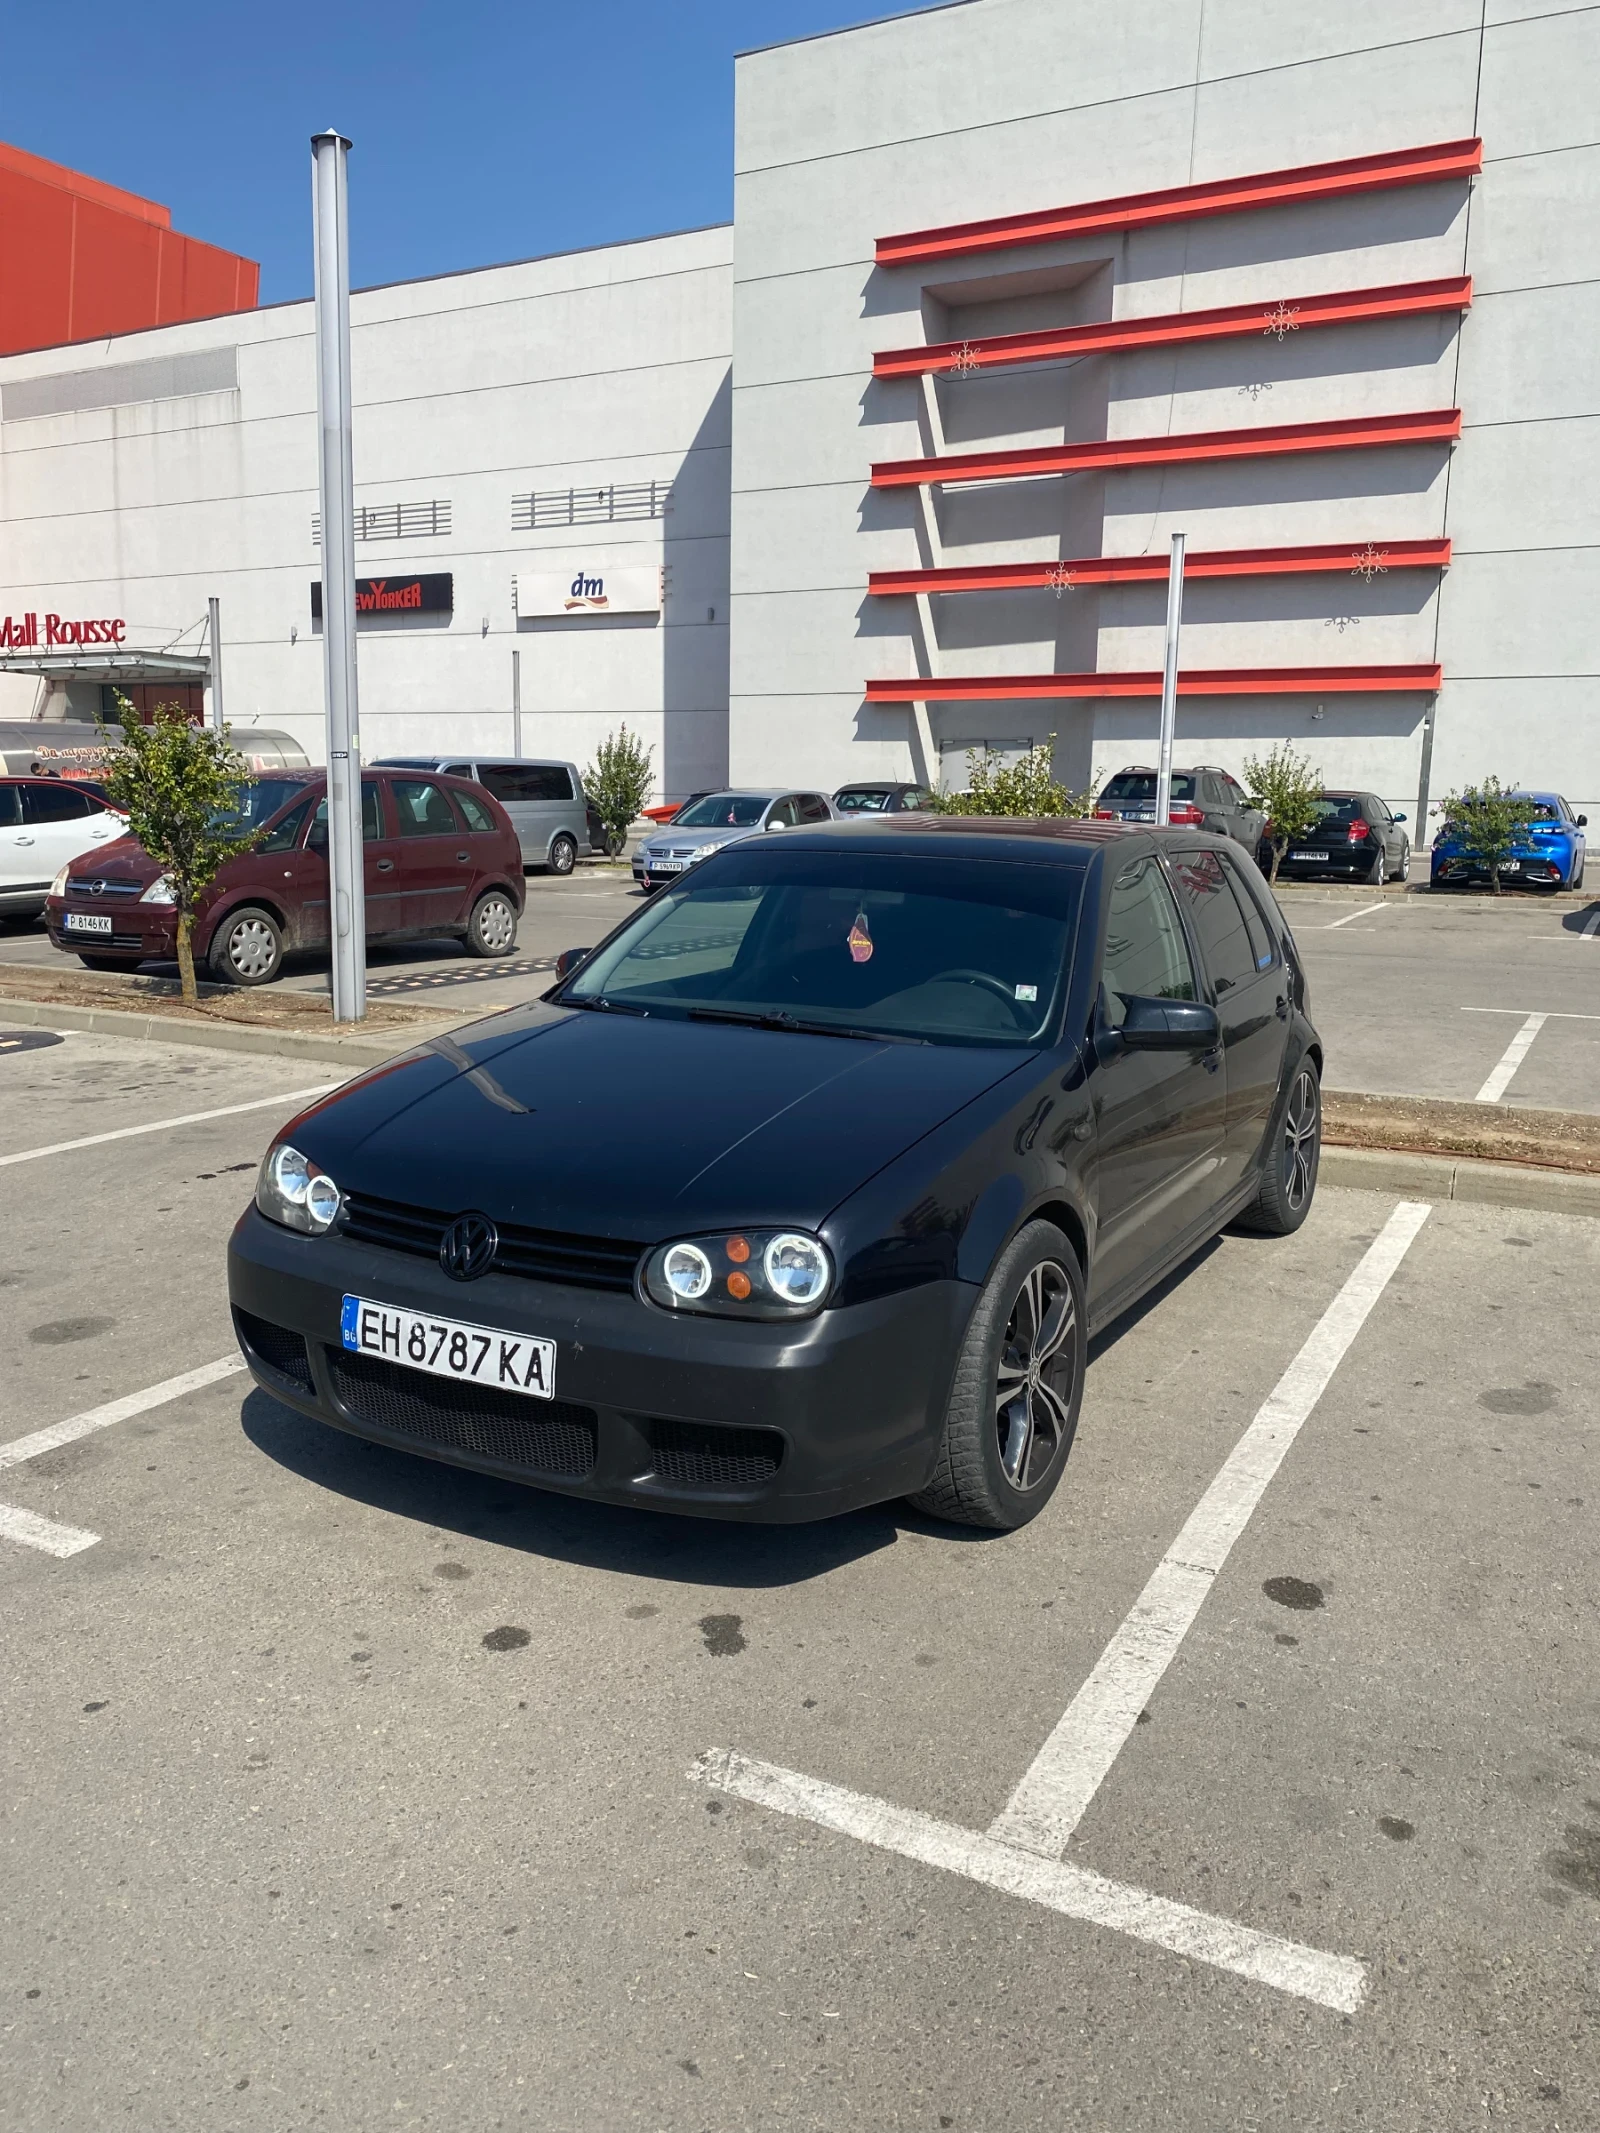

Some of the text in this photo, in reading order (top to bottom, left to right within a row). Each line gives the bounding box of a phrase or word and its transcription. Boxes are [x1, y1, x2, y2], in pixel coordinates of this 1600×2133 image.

[571, 572, 603, 597] dm
[45, 614, 126, 645] Rousse
[70, 915, 110, 931] P 8146 KK
[361, 1308, 545, 1391] EH 8787 KA
